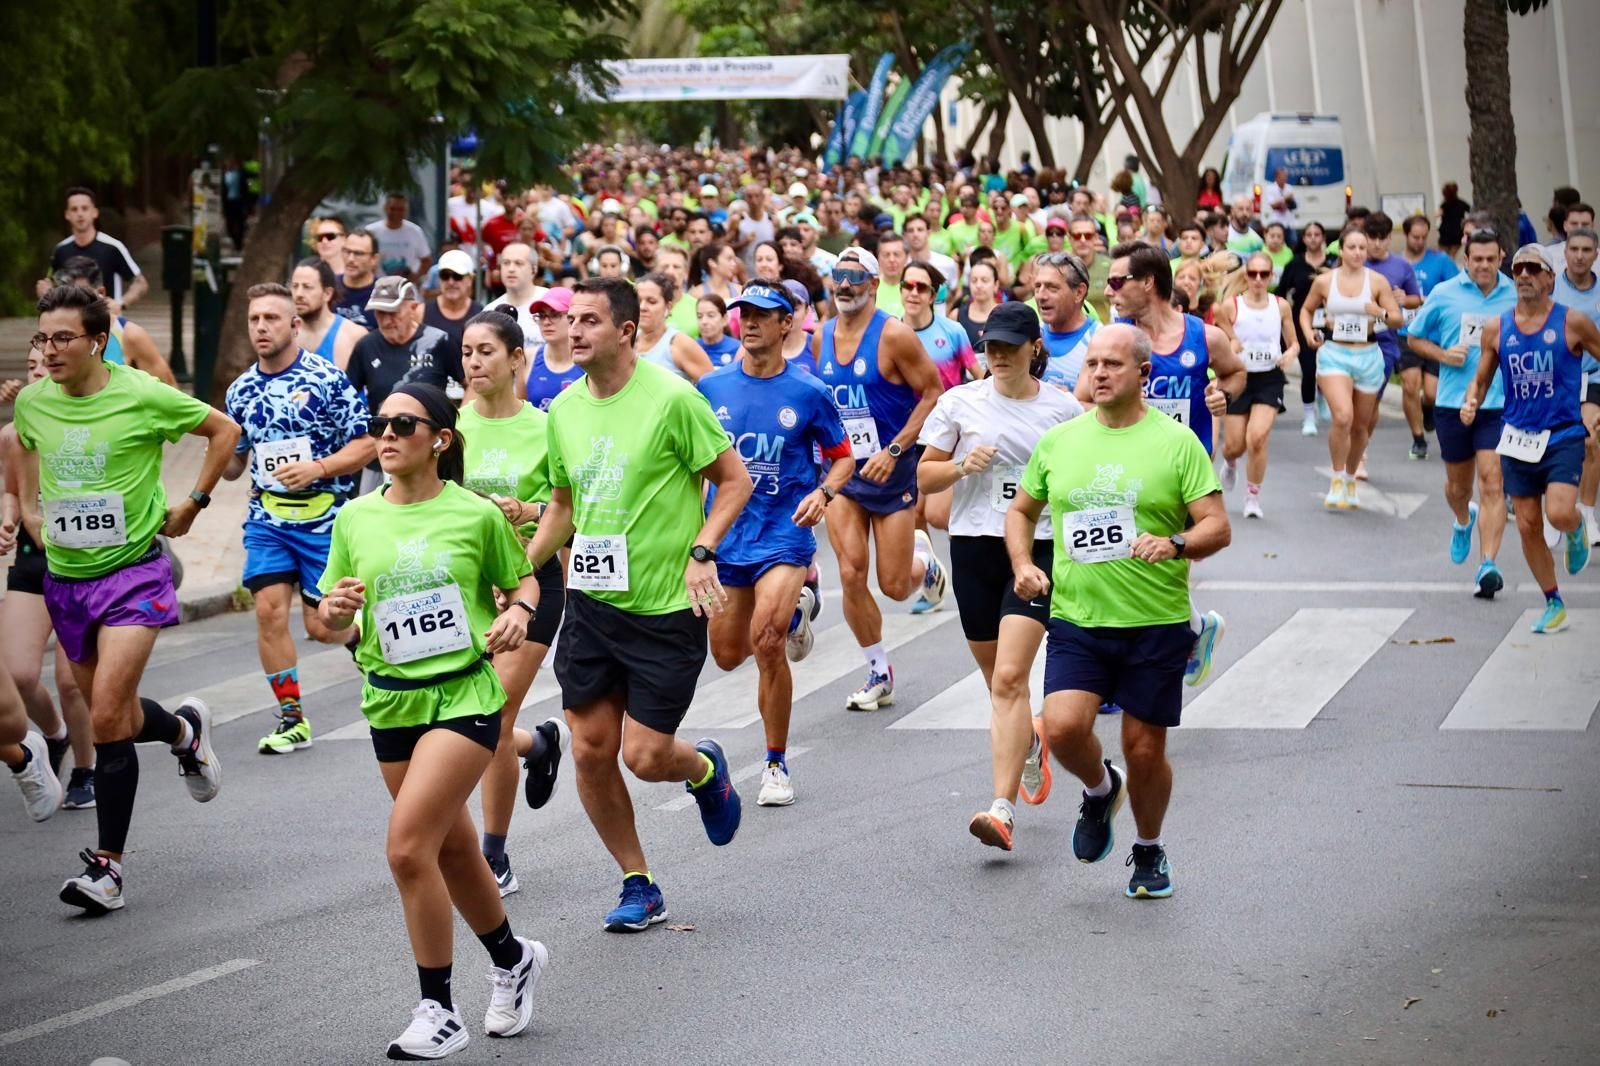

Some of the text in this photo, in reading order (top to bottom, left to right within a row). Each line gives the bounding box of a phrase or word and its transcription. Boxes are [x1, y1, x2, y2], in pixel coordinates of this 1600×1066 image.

[1508, 350, 1554, 376] RCM
[1512, 380, 1554, 400] 1873
[54, 513, 116, 532] 1189
[1072, 525, 1123, 549] 226
[573, 554, 615, 573] 621
[385, 609, 456, 641] 1162
